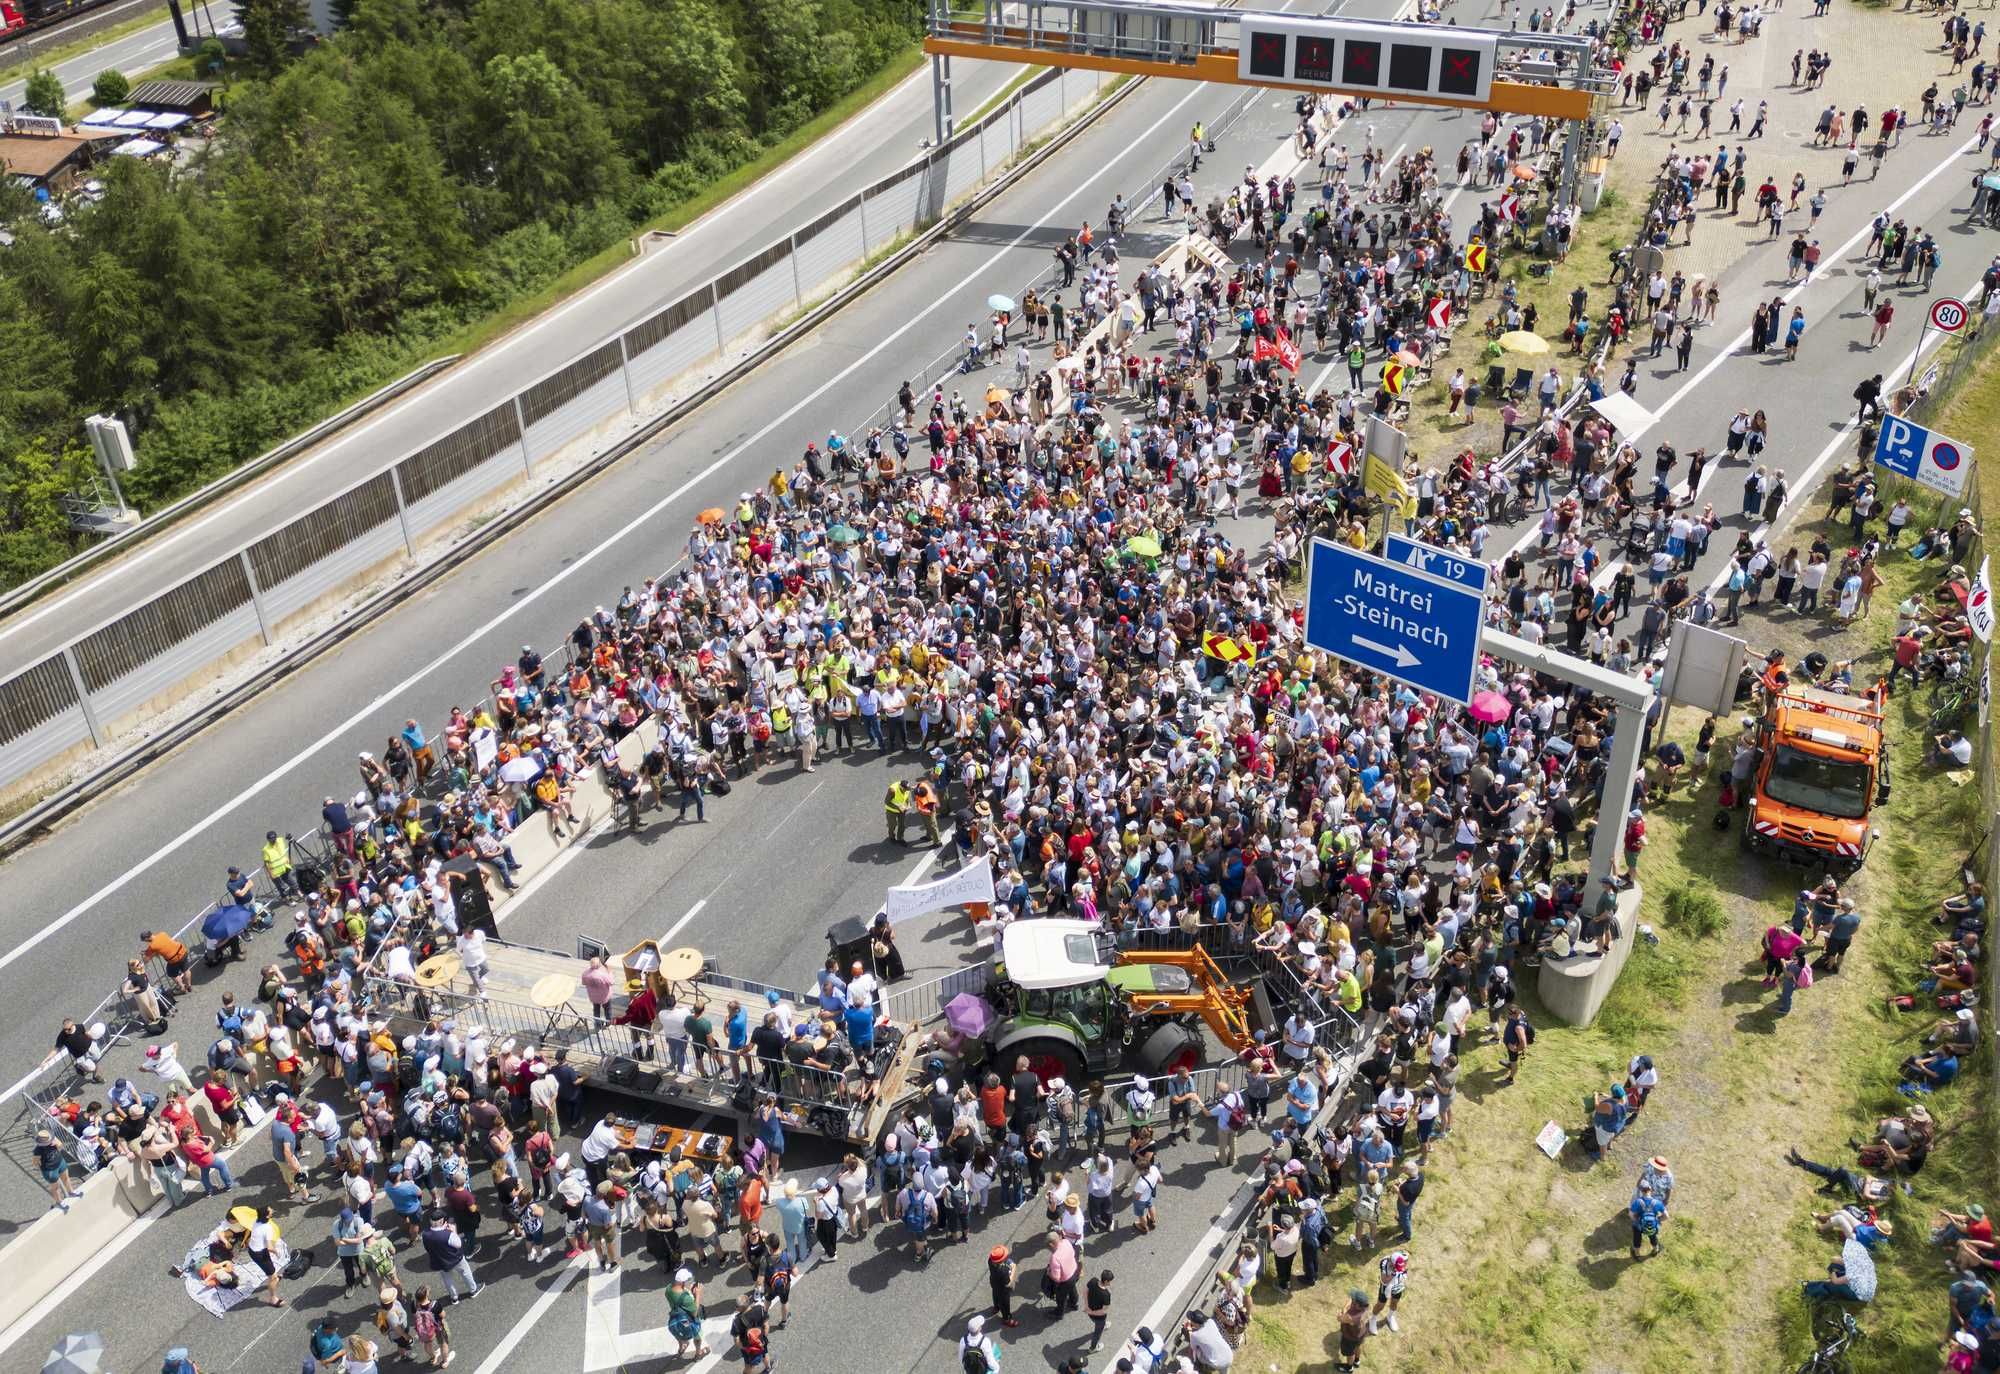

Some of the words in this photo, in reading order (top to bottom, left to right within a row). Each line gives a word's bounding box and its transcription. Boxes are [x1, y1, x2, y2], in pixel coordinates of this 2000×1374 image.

[1939, 306, 1960, 325] 80
[1885, 419, 1911, 452] P
[1443, 559, 1466, 580] 19
[1354, 568, 1433, 615] Matrei
[1334, 594, 1448, 649] -Steinach
